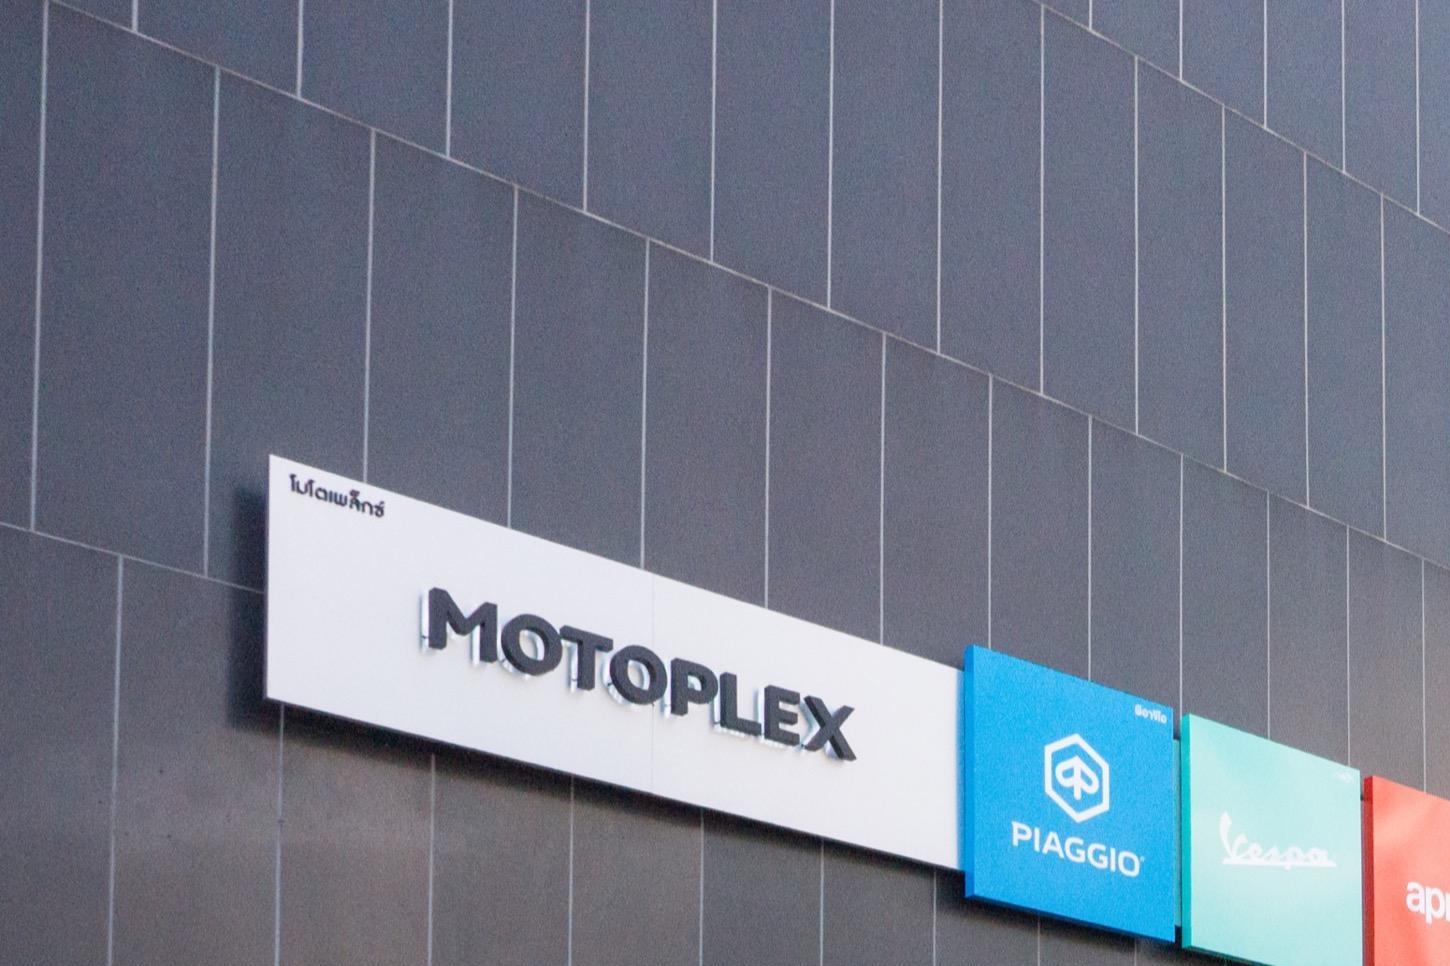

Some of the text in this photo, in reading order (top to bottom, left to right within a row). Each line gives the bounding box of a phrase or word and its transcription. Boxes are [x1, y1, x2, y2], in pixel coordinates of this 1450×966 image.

[424, 586, 858, 762] MOTOPLEX
[1011, 820, 1142, 878] PIAGGIO
[1219, 811, 1337, 870] Vespa
